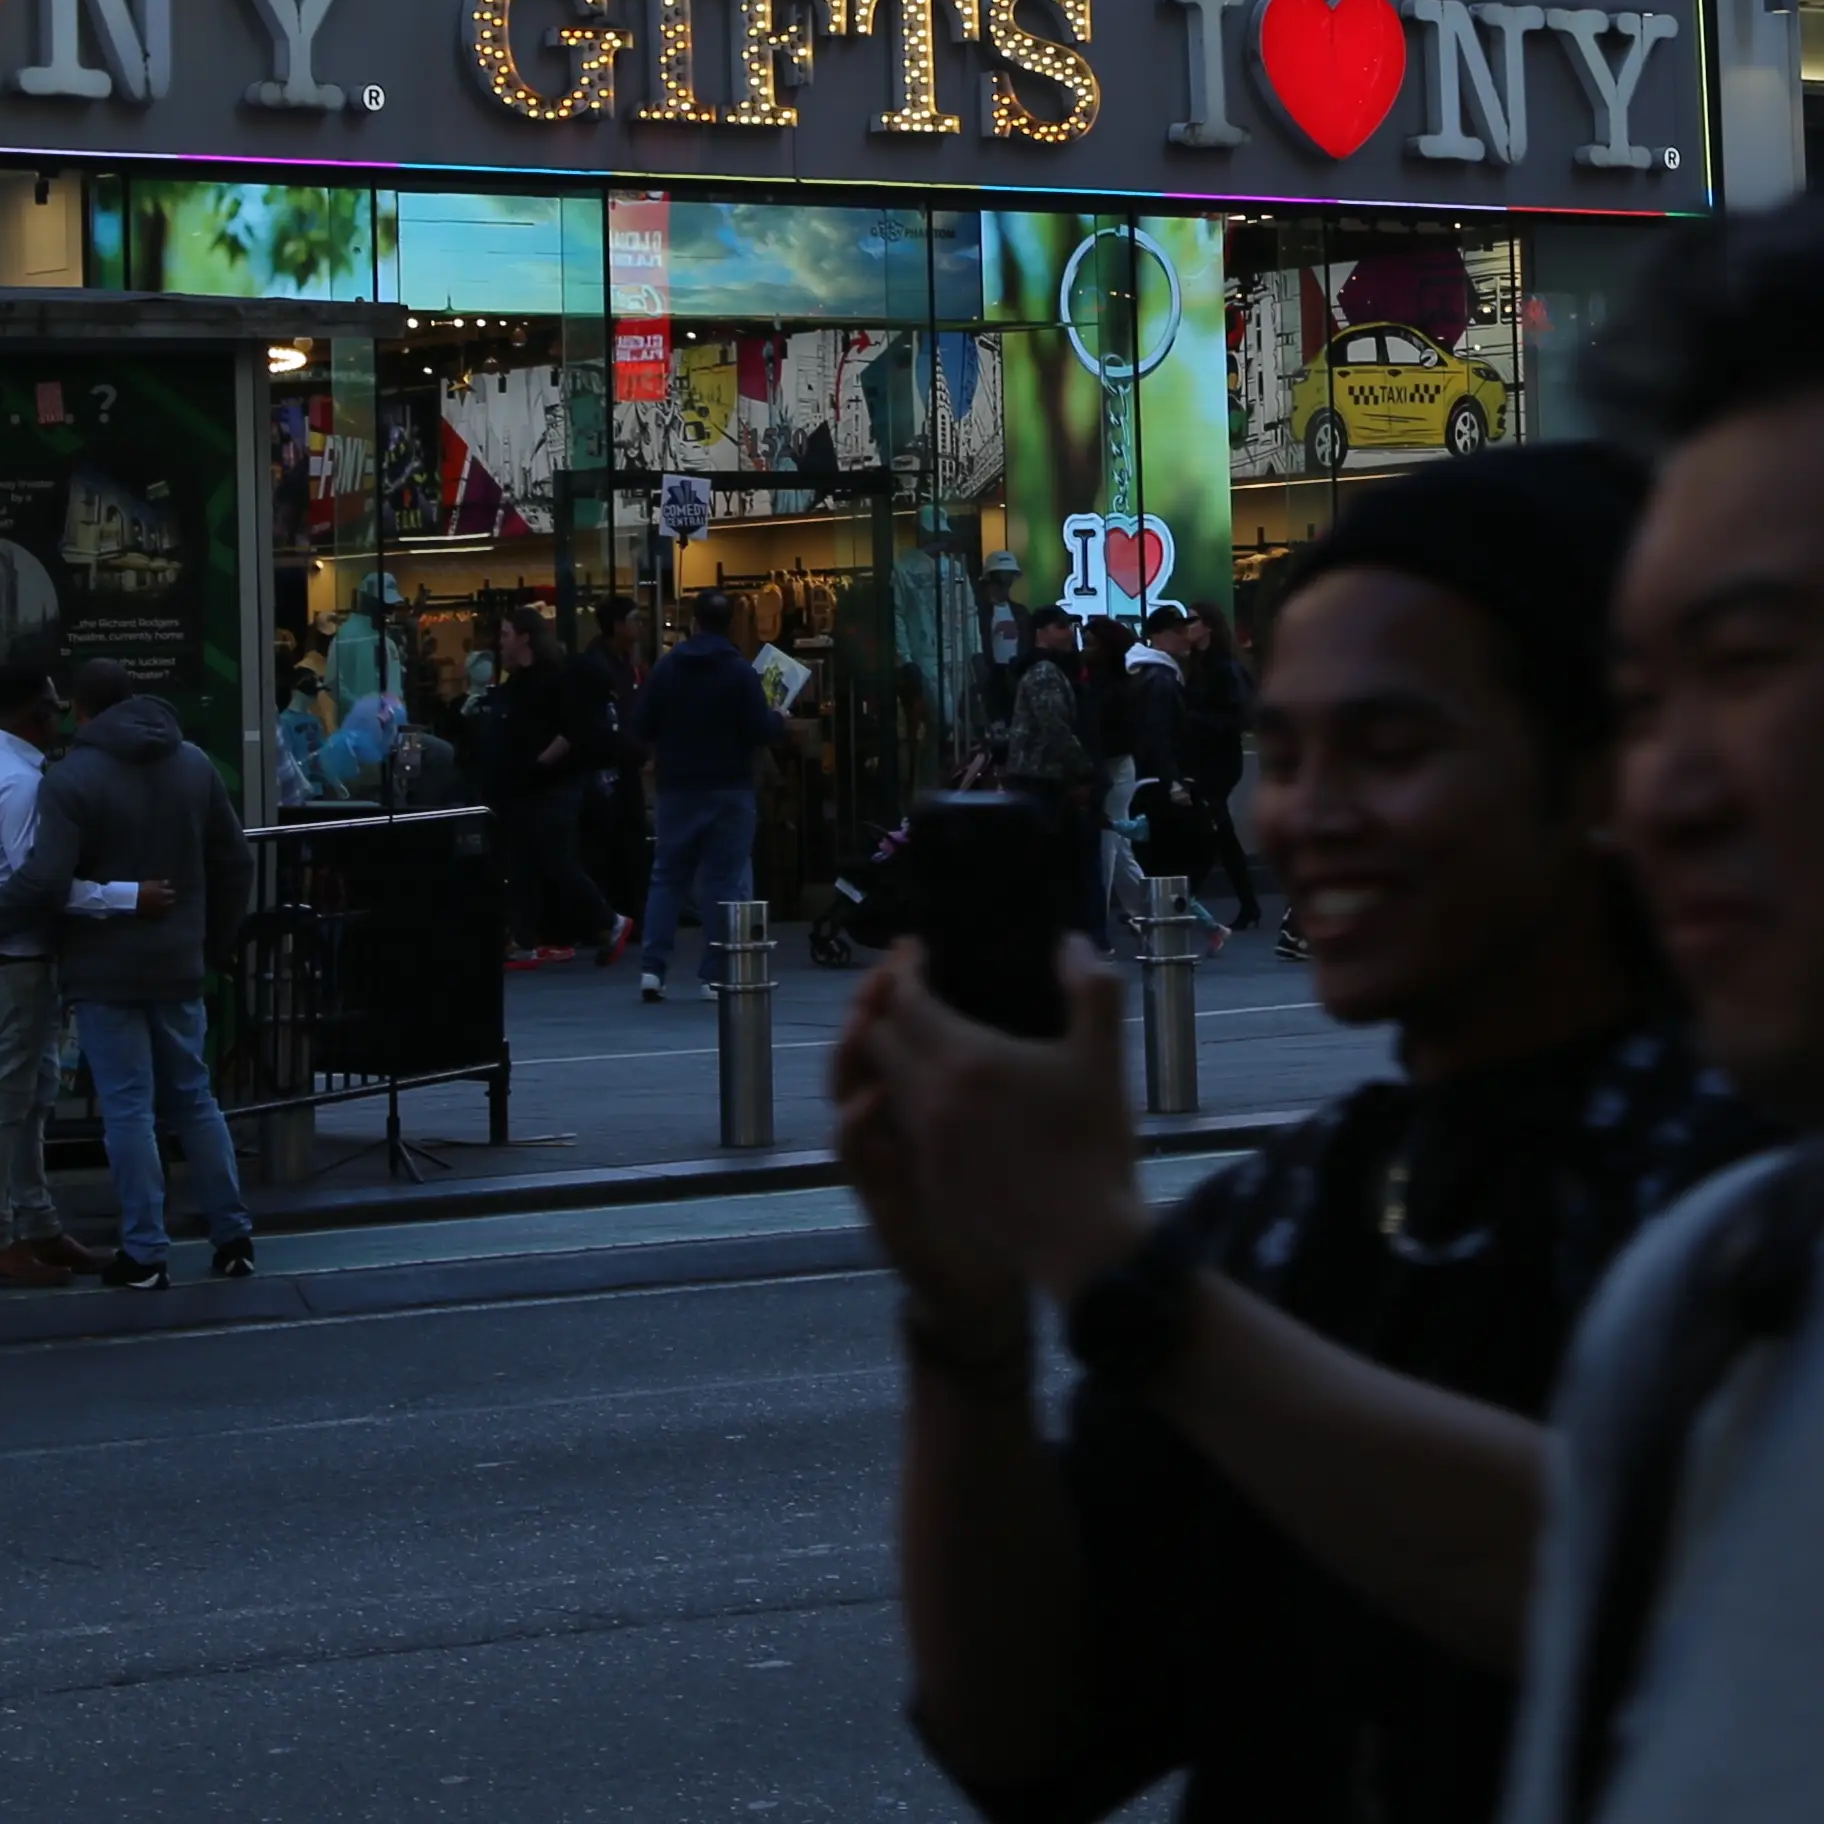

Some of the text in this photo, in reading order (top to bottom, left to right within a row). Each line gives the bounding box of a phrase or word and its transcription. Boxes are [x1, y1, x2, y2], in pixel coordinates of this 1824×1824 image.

[1379, 385, 1408, 405] TAXI
[663, 503, 707, 518] COMEDY
[665, 516, 707, 528] CENTRAL
